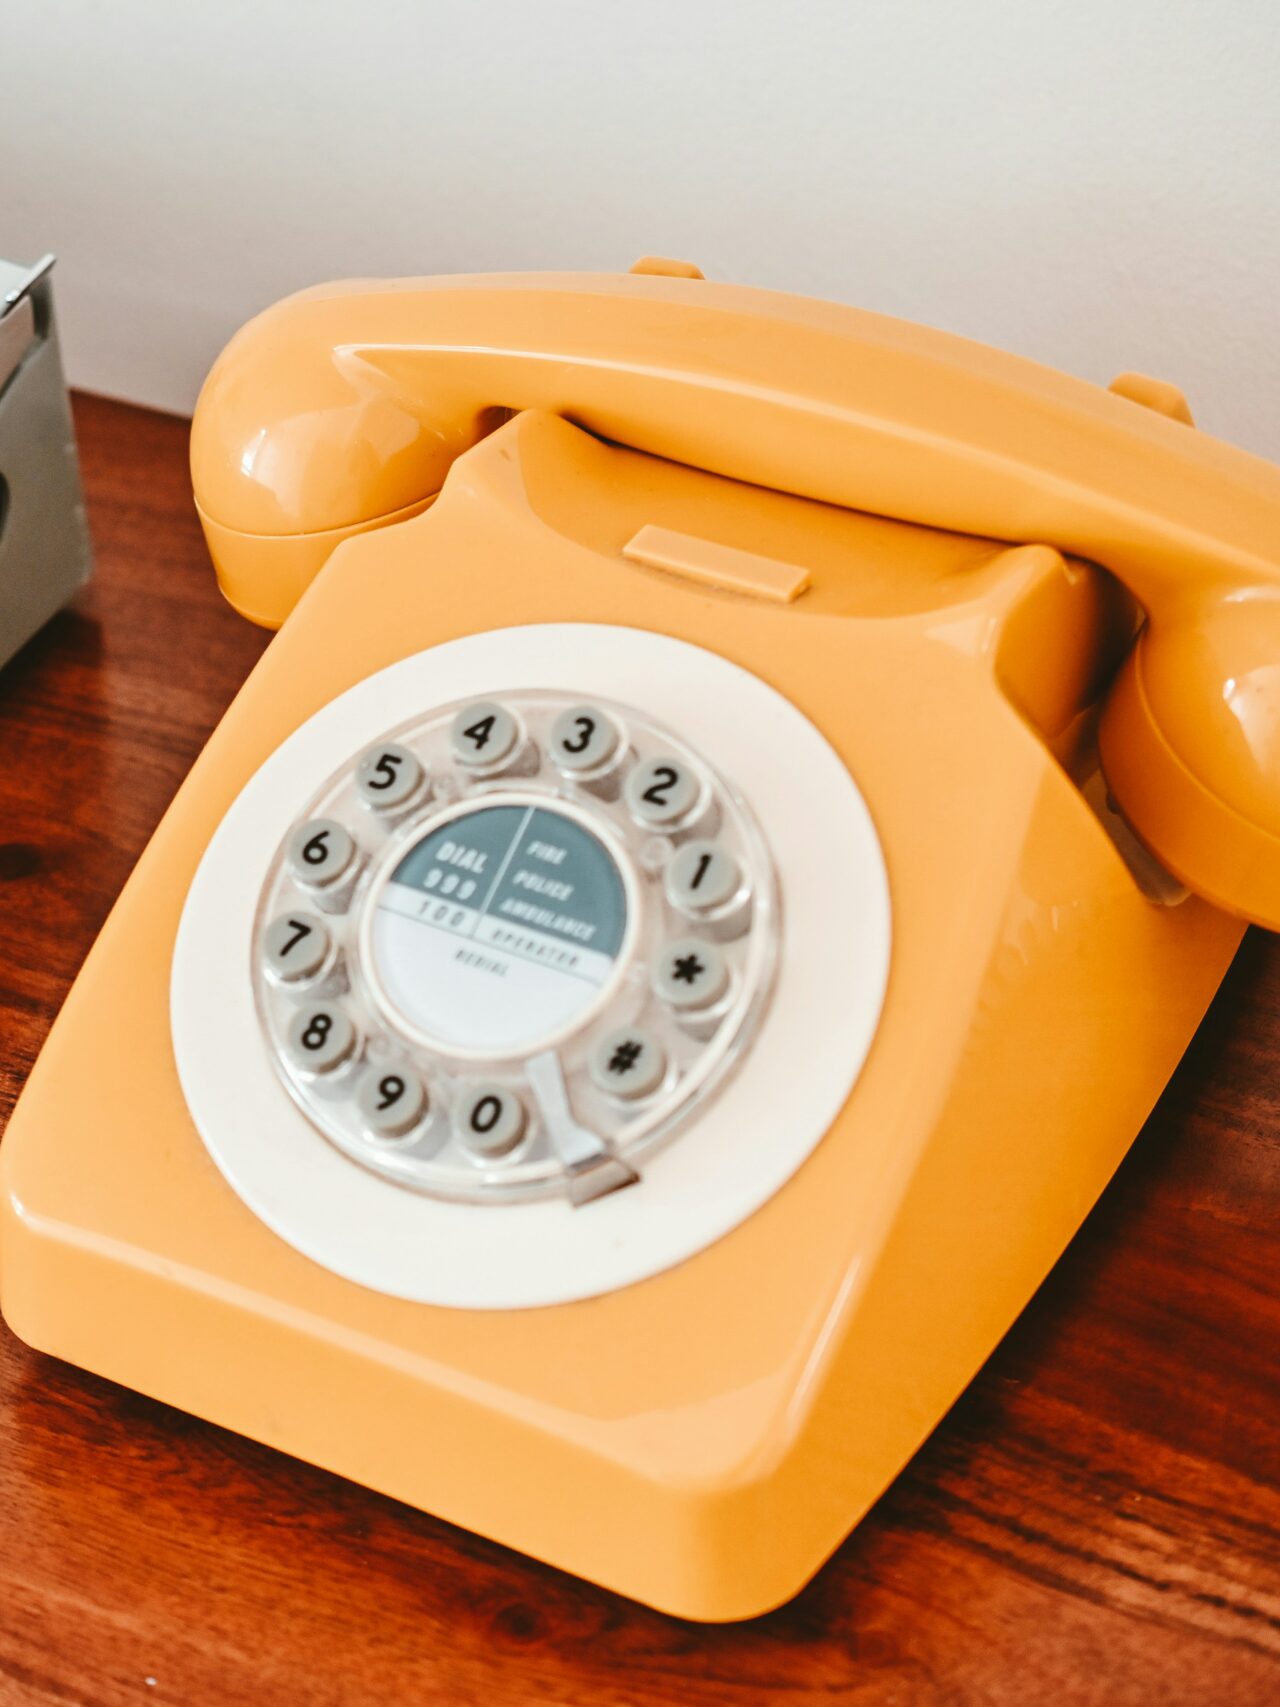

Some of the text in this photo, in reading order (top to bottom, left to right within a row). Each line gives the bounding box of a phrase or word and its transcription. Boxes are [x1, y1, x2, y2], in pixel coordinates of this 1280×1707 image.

[463, 715, 497, 751] 4
[562, 716, 596, 754] 3
[367, 753, 403, 791] 5
[641, 766, 679, 807] 2
[301, 830, 330, 866] 6
[435, 841, 488, 874] DIAL
[526, 840, 568, 866] FIRE
[422, 867, 478, 901] 999
[512, 869, 576, 902] POLICE
[690, 853, 713, 890] 1
[419, 899, 580, 968] 100 OPERATOR
[498, 896, 598, 942] AMBULANCE
[279, 919, 312, 957] 7
[300, 1013, 333, 1051] 8
[376, 1074, 406, 1111] 9
[469, 1095, 503, 1134] 0
